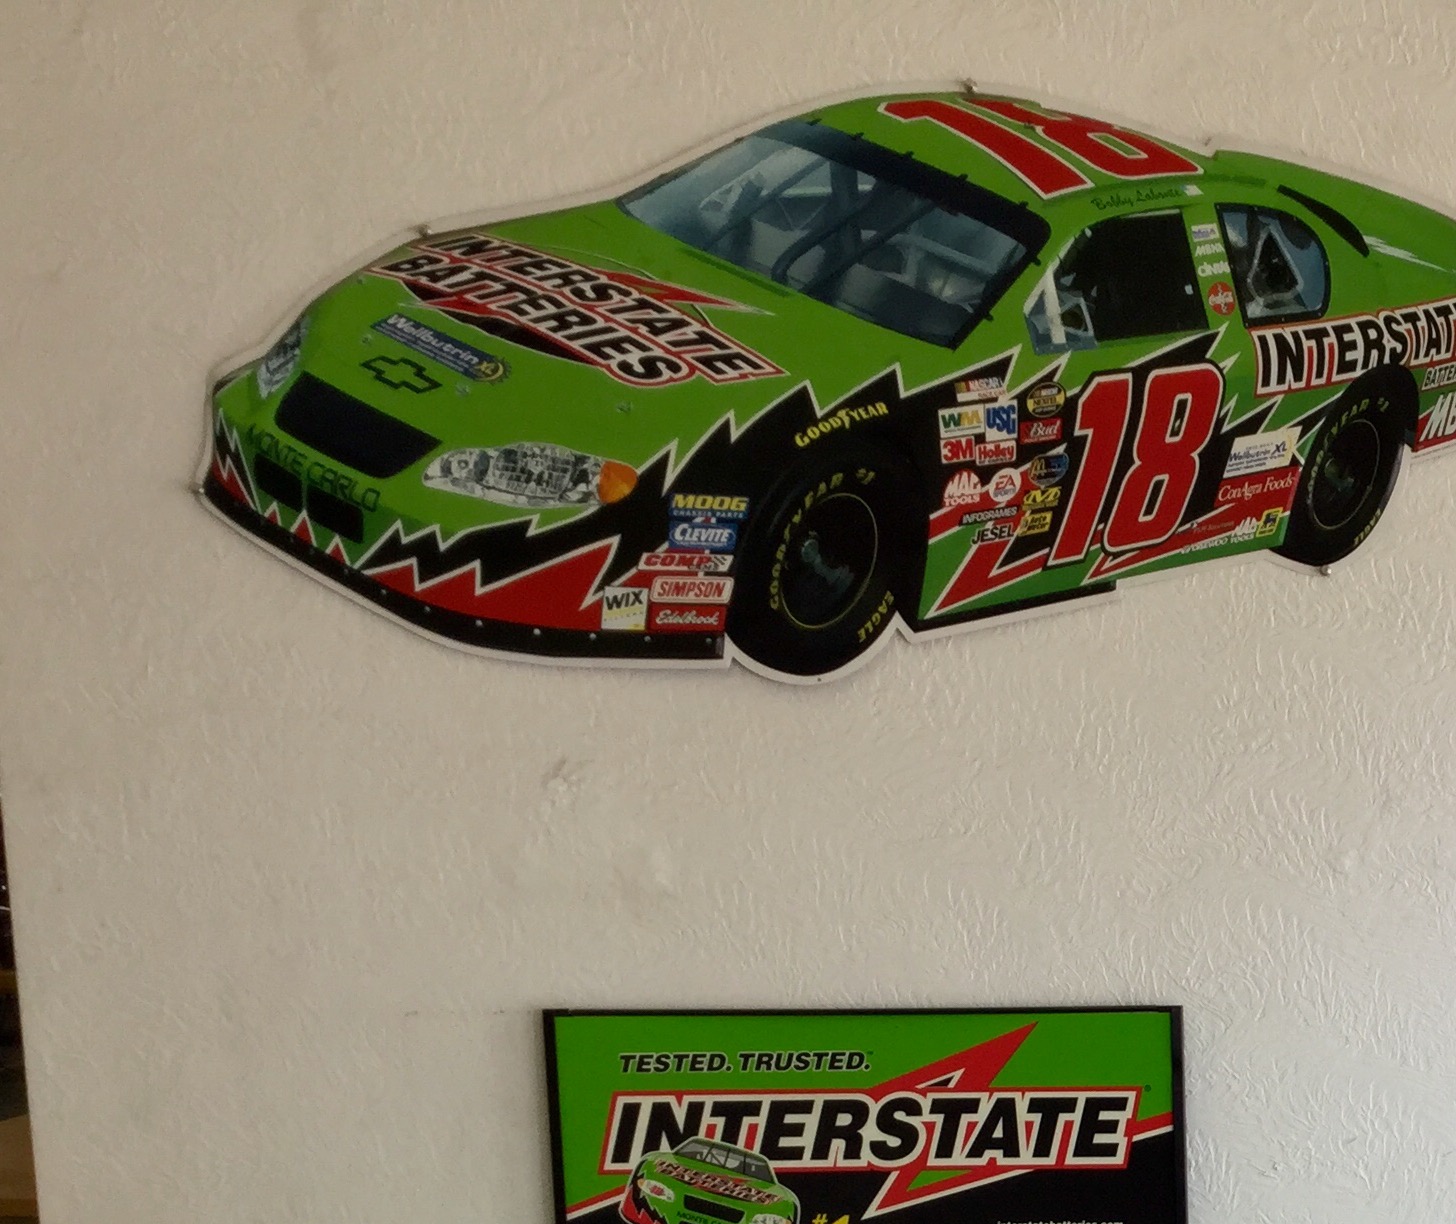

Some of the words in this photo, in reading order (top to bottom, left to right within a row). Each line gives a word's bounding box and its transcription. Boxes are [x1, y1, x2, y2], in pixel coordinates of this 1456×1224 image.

[380, 252, 685, 381] BATTERIES
[420, 235, 767, 378] INTERSTATE
[794, 401, 889, 448] GOODYEAR
[986, 405, 1016, 434] USG
[943, 438, 975, 461] 3M
[979, 443, 1014, 460] Holley
[1048, 363, 1223, 567] 18
[673, 493, 748, 512] MOOG
[674, 523, 731, 542] CLEVITE
[971, 524, 1014, 545] JESEL
[643, 554, 712, 568] COMP
[605, 590, 644, 611] WIX
[658, 581, 726, 598] SIMPSON
[619, 1052, 732, 1074] TESTED.
[739, 1050, 871, 1072] TRUSTED.
[610, 1095, 1132, 1167] INTERSTATE
